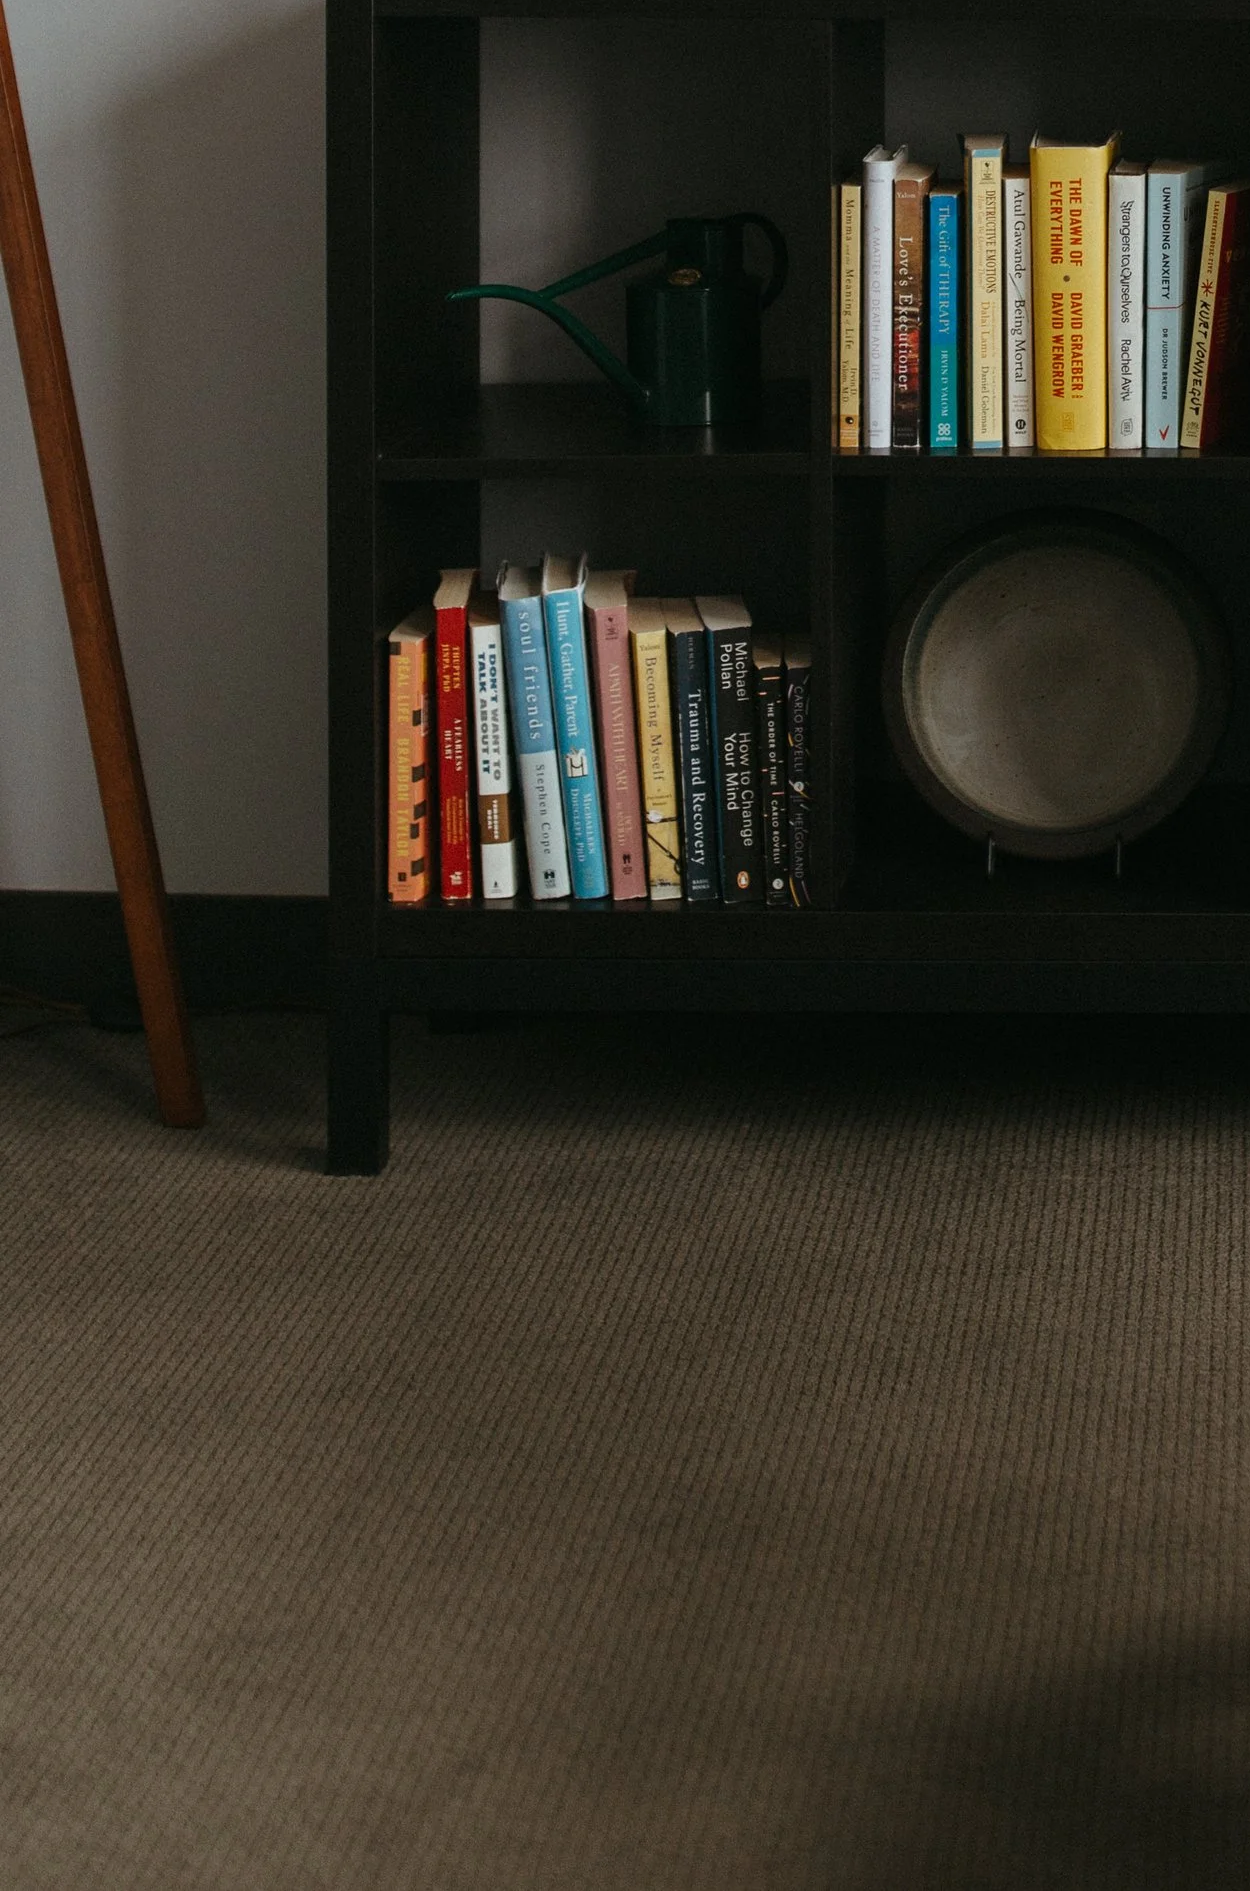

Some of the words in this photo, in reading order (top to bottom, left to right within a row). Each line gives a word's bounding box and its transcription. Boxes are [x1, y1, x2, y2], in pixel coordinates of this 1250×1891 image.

[1014, 189, 1026, 216] Atul
[1069, 178, 1082, 204] THE
[845, 199, 855, 241] Momma
[939, 205, 950, 225] The
[985, 190, 997, 246] DESTRUCTIVE
[1050, 181, 1063, 264] EVERYTHING
[1070, 209, 1082, 245] DAWN
[1119, 201, 1135, 252] Strangers
[1162, 186, 1171, 250] UNWINDING
[872, 237, 880, 275] MATTER
[939, 230, 951, 253] Gift
[1014, 220, 1026, 278] Gawande
[1071, 250, 1083, 266] OF
[898, 237, 913, 286] Love's
[939, 256, 951, 268] of
[985, 249, 997, 294] EMOTIONS
[1161, 253, 1170, 299] ANXIETY
[842, 269, 855, 316] Meaning
[872, 280, 880, 293] OF
[939, 270, 950, 334] THERAPY
[1120, 268, 1132, 323] Ourselves
[872, 299, 880, 332] DEATH
[980, 301, 991, 327] Dalai
[1011, 300, 1026, 335] Being
[1052, 292, 1064, 329] DAVID
[1071, 292, 1083, 329] DAVID
[1197, 300, 1212, 338] KURT
[845, 328, 855, 350] Life
[872, 336, 880, 359] AND
[898, 294, 913, 390] Executioner
[980, 331, 990, 358] Lama
[1162, 328, 1168, 338] DR
[872, 365, 880, 382] LIFE
[1014, 340, 1027, 383] Mortal
[1052, 334, 1064, 398] WENGROW
[1071, 334, 1084, 391] GRAEBER
[1120, 340, 1132, 376] Rachel
[980, 366, 990, 393] Daniel
[1120, 378, 1132, 401] Aviv
[1189, 342, 1206, 415] VONNEGUT
[980, 396, 990, 434] Goleman
[518, 611, 536, 653] soul
[556, 601, 571, 640] Hunt,
[397, 657, 410, 689] REAL
[452, 646, 460, 689] THUPTEN
[478, 652, 487, 692] TALK
[489, 654, 498, 703] DON'T
[560, 642, 576, 692] Gather,
[720, 644, 733, 689] Pollan
[735, 642, 749, 701] Michael
[397, 695, 410, 721] LIFE
[523, 665, 542, 740] friends
[645, 658, 660, 727] Becoming
[767, 702, 775, 717] THE
[794, 686, 804, 723] CARLO
[480, 698, 489, 754] ABOUT
[491, 708, 500, 755] WANT
[564, 695, 580, 737] Parent
[688, 689, 702, 751] Trauma
[767, 721, 776, 747] ORDER
[444, 730, 453, 760] HEART
[455, 726, 463, 771] FEARLESS
[647, 734, 666, 781] Myself
[724, 733, 737, 767] Your
[738, 732, 752, 766] How
[768, 751, 776, 763] OF
[794, 727, 804, 772] ROVELLI
[397, 738, 410, 800] BRANDON
[483, 759, 490, 774] IT
[493, 760, 502, 781] TO
[690, 758, 704, 786] and
[741, 771, 752, 785] to
[769, 765, 777, 786] TIME
[534, 764, 548, 815] Stephen
[725, 773, 740, 810] Mind
[397, 807, 410, 857] TAYLOR
[691, 792, 706, 865] Recovery
[739, 790, 755, 846] Change
[771, 800, 779, 827] CARLO
[537, 822, 552, 854] Cope
[772, 831, 781, 864] ROVELLI
[794, 813, 805, 878] HELGOLAND
